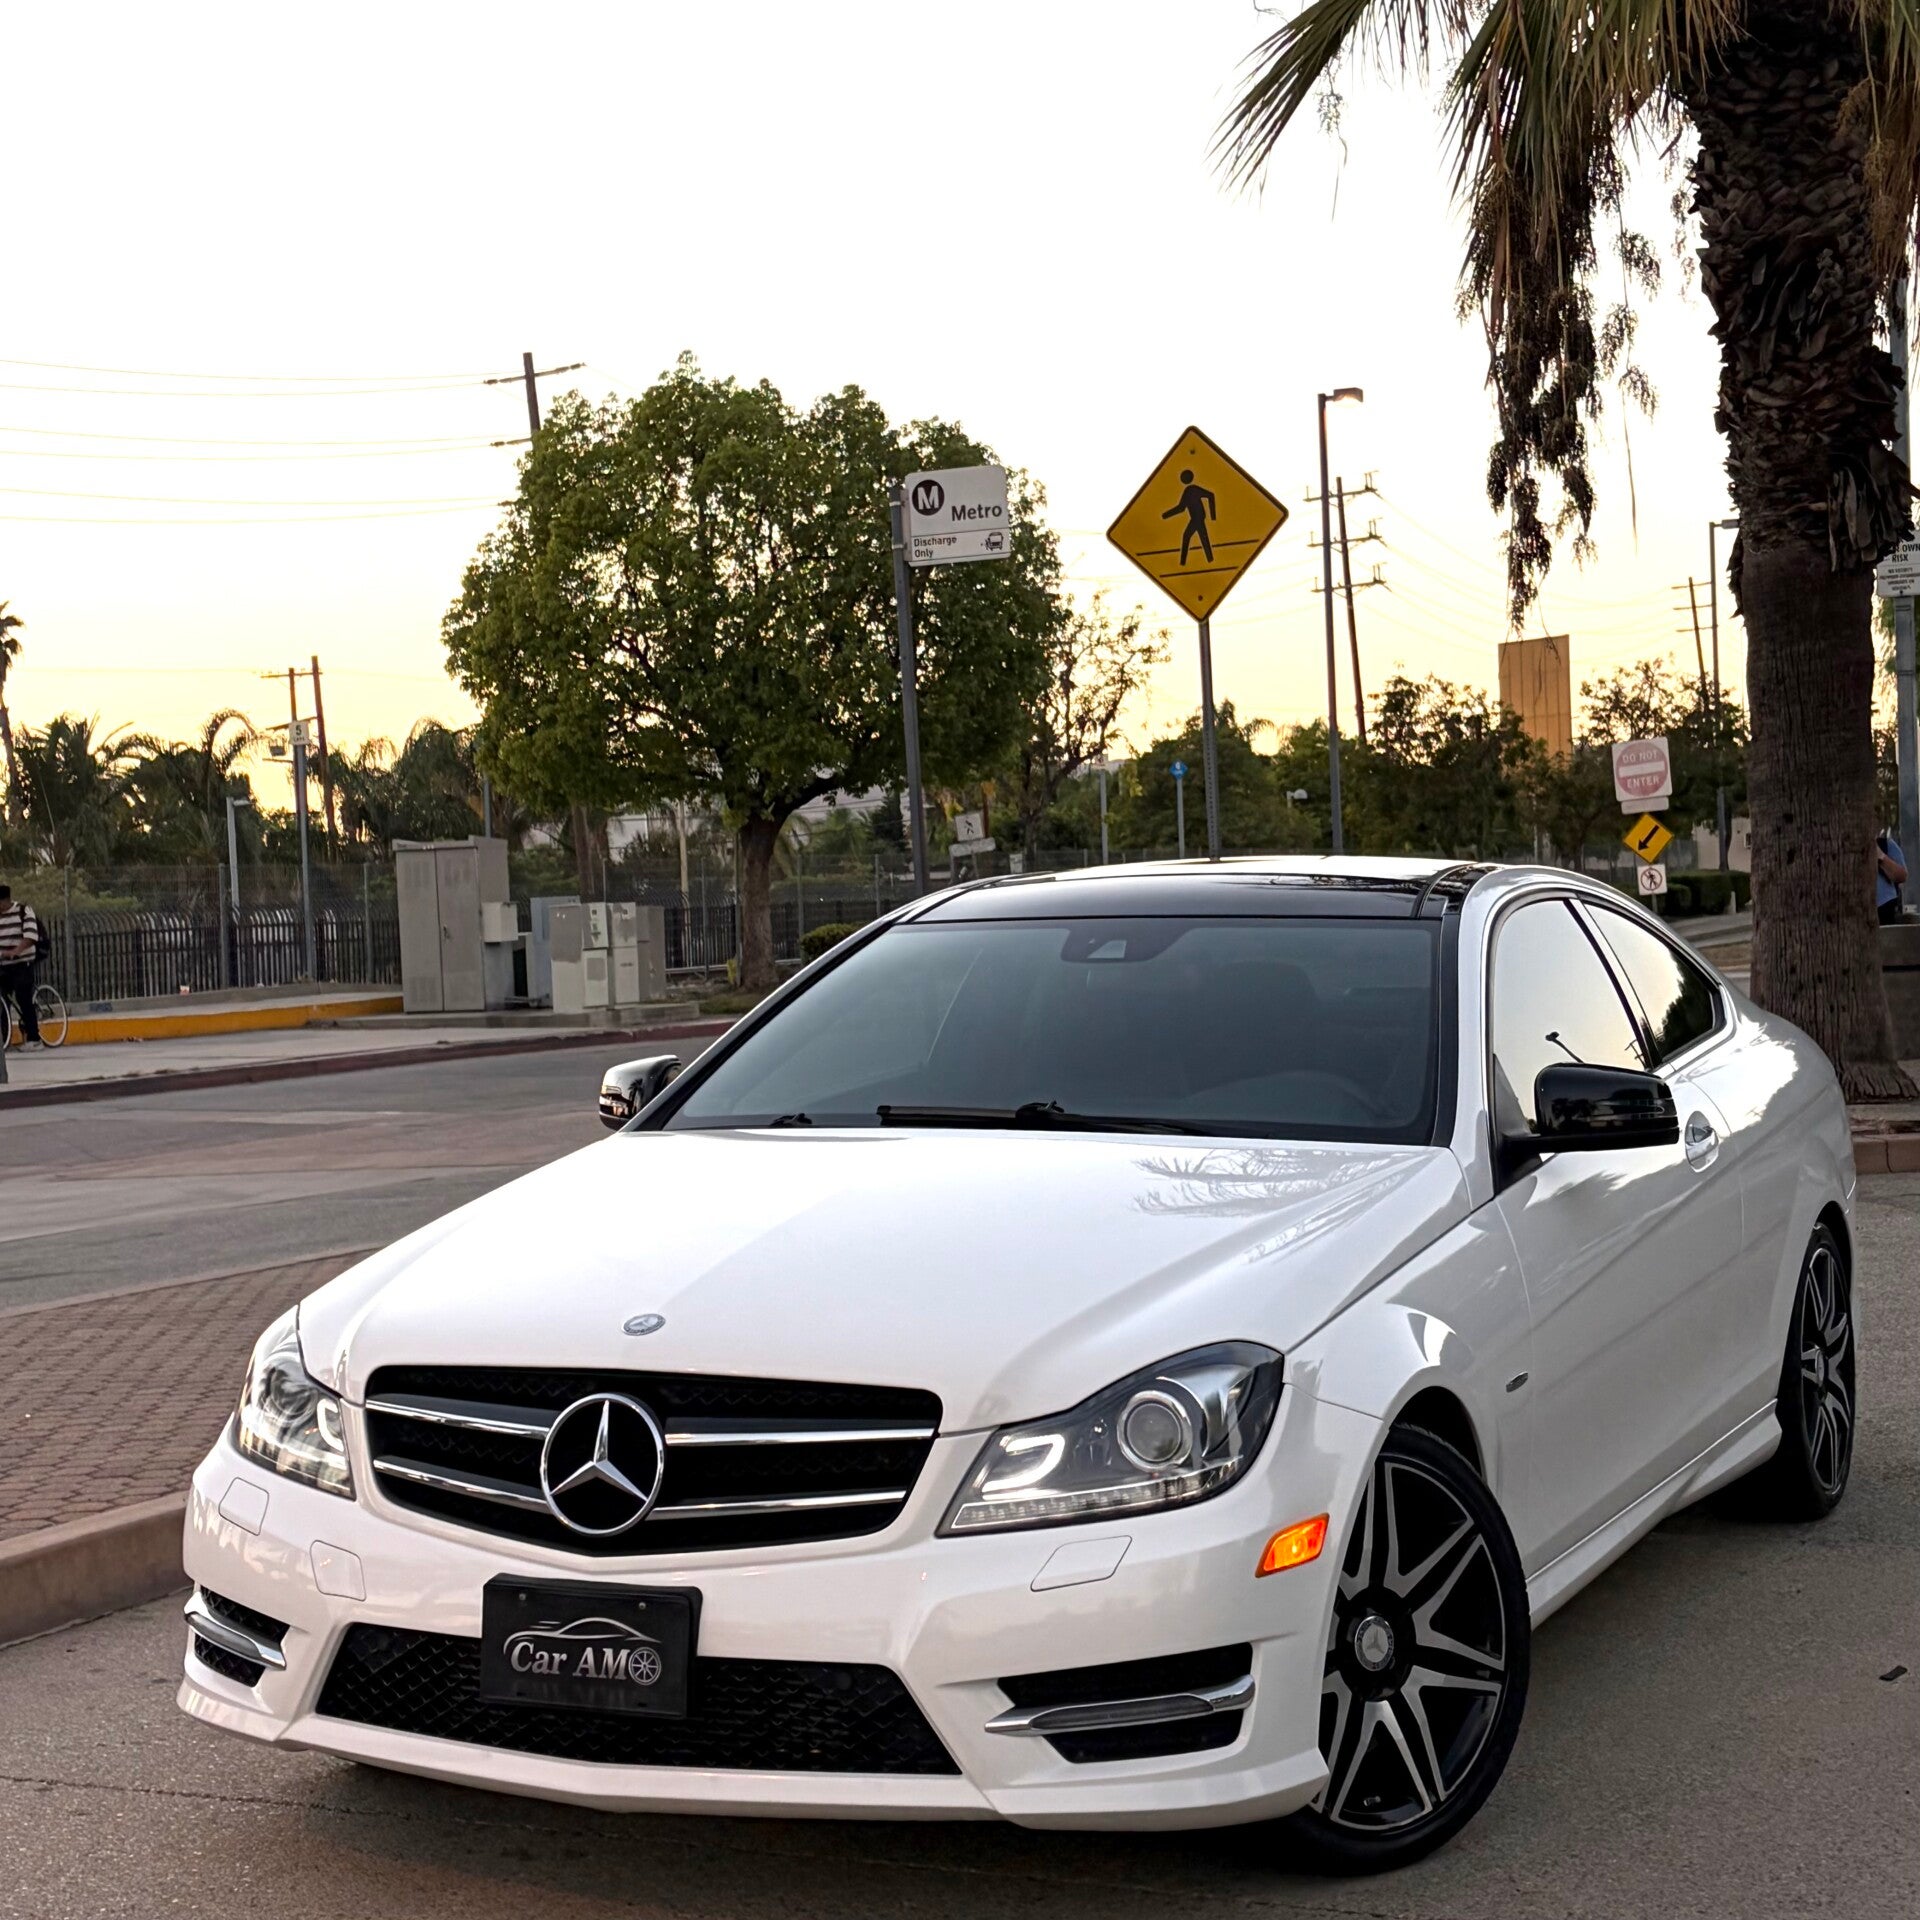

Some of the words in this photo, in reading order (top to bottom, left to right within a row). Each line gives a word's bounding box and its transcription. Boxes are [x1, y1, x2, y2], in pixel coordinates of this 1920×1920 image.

[951, 504, 1002, 521] Metro
[914, 536, 957, 548] Discharge
[915, 549, 933, 558] Only
[1622, 753, 1636, 763] DO
[1639, 750, 1657, 761] NOT
[1626, 775, 1660, 789] ENTER
[510, 1641, 568, 1675] Car
